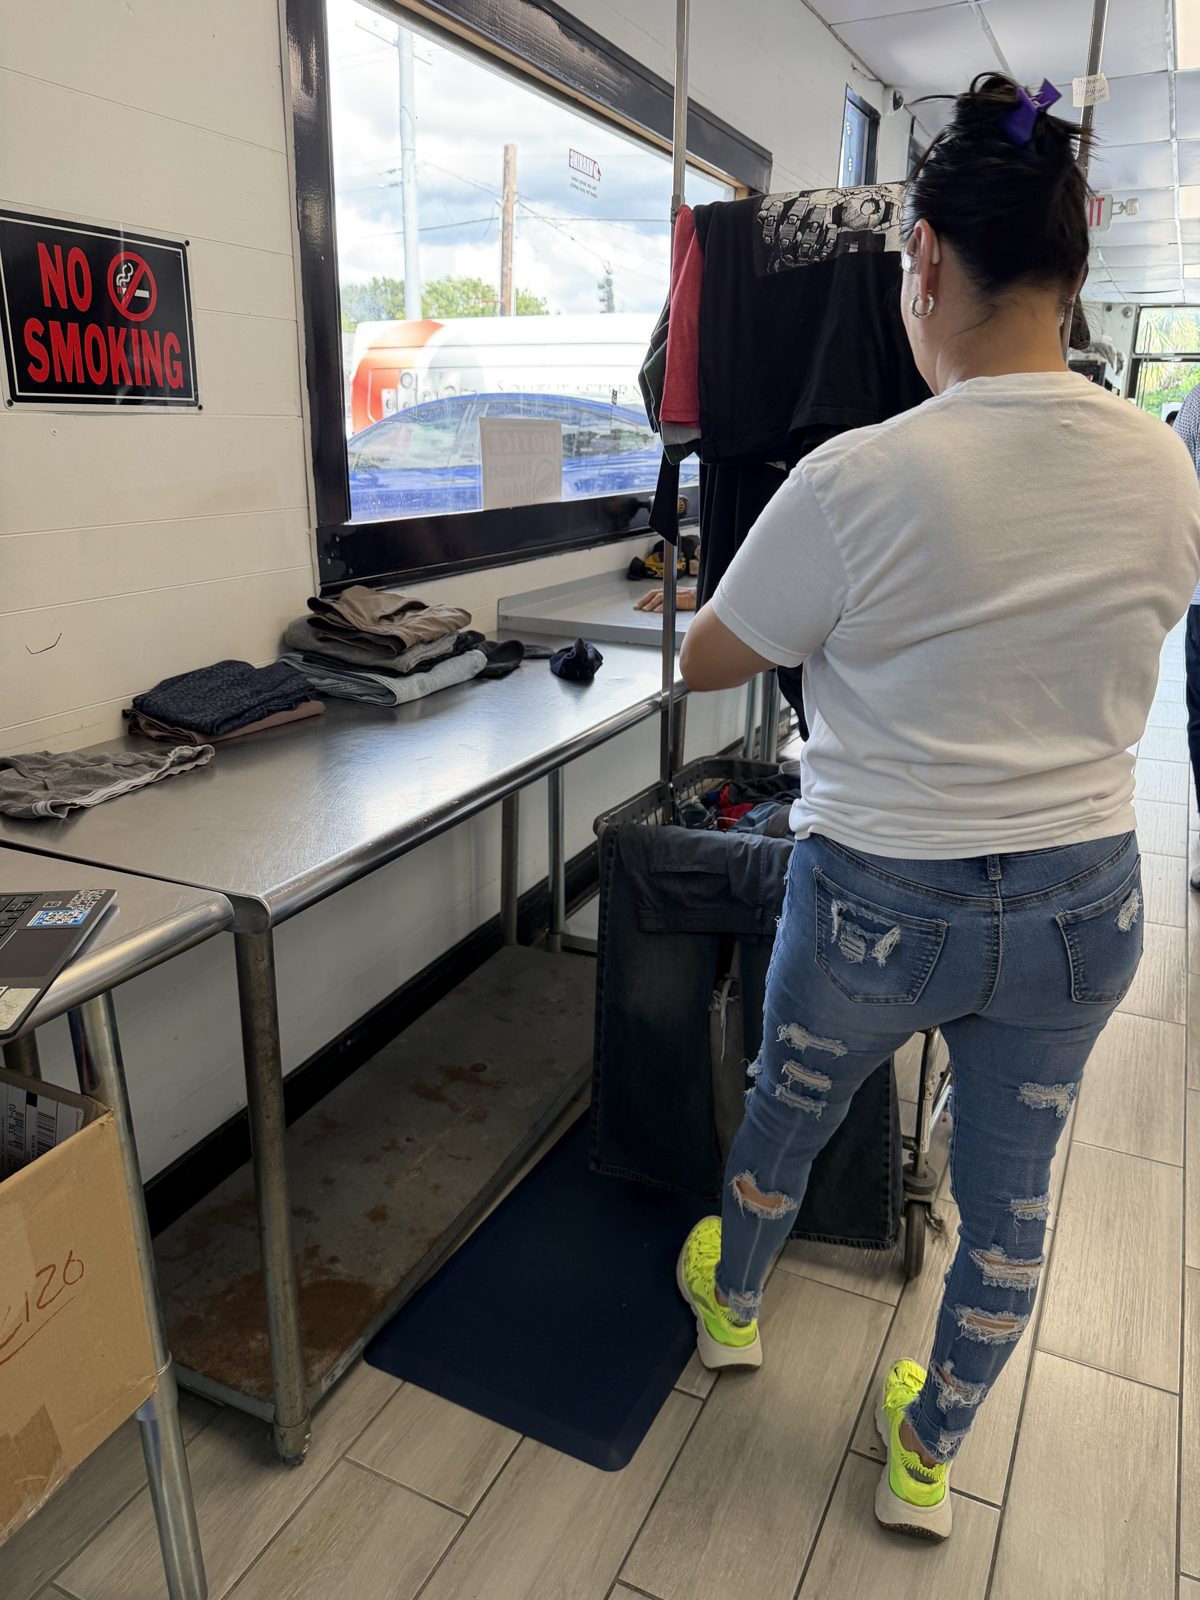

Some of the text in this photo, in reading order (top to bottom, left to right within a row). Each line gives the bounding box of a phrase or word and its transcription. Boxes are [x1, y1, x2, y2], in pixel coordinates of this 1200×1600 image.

[1087, 197, 1105, 227] IT
[37, 242, 92, 312] NO
[24, 317, 184, 389] SMOKING
